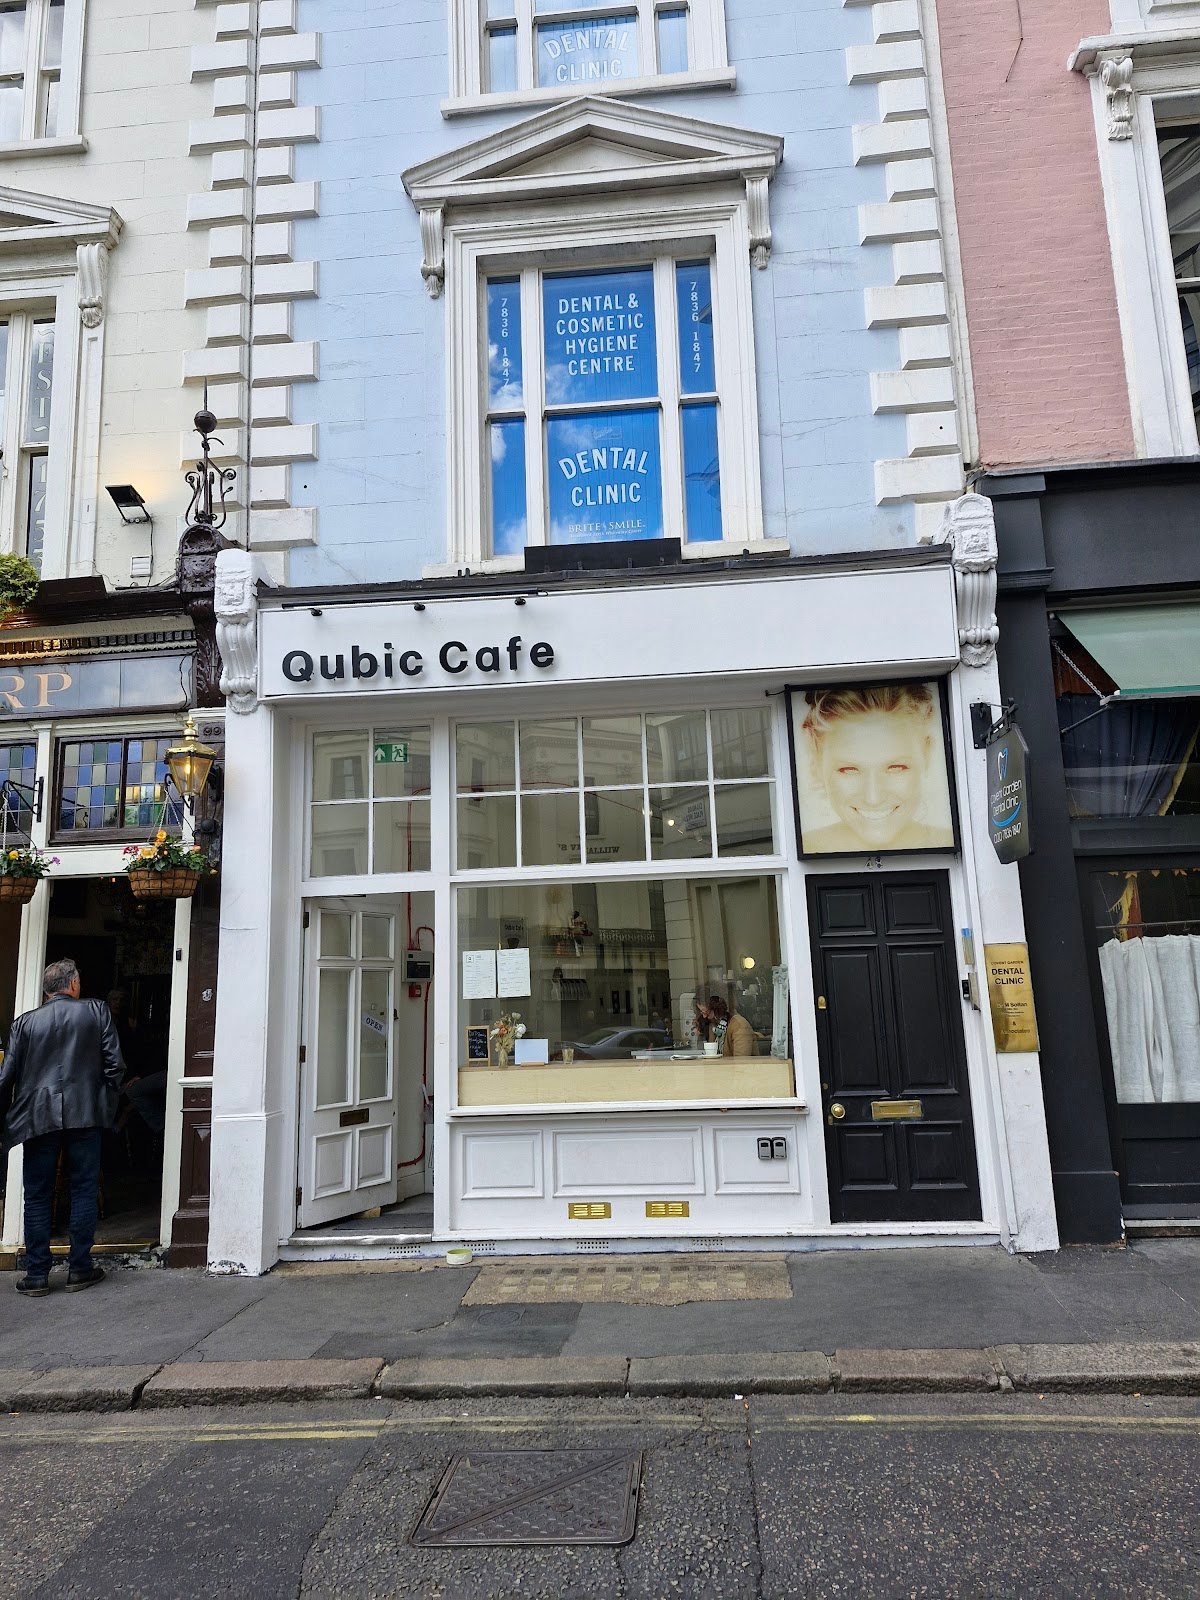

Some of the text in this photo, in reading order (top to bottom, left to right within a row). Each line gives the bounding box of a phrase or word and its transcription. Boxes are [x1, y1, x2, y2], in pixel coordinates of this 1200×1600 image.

[543, 29, 630, 59] DENTAL
[556, 59, 622, 82] CLINIC
[558, 292, 640, 315] DENTAL &
[501, 297, 509, 338] 7836
[556, 312, 645, 336] COSMETIC
[690, 282, 701, 373] 7836 1847
[565, 334, 639, 355] HYGIENE
[568, 355, 635, 376] CENTRE
[558, 446, 649, 480] DENTAL
[571, 482, 641, 507] CLINIC
[281, 635, 555, 683] Qubic Cafe
[991, 967, 1025, 976] DENTAL
[994, 977, 1024, 985] CLINIC
[365, 1017, 383, 1031] OPEN
